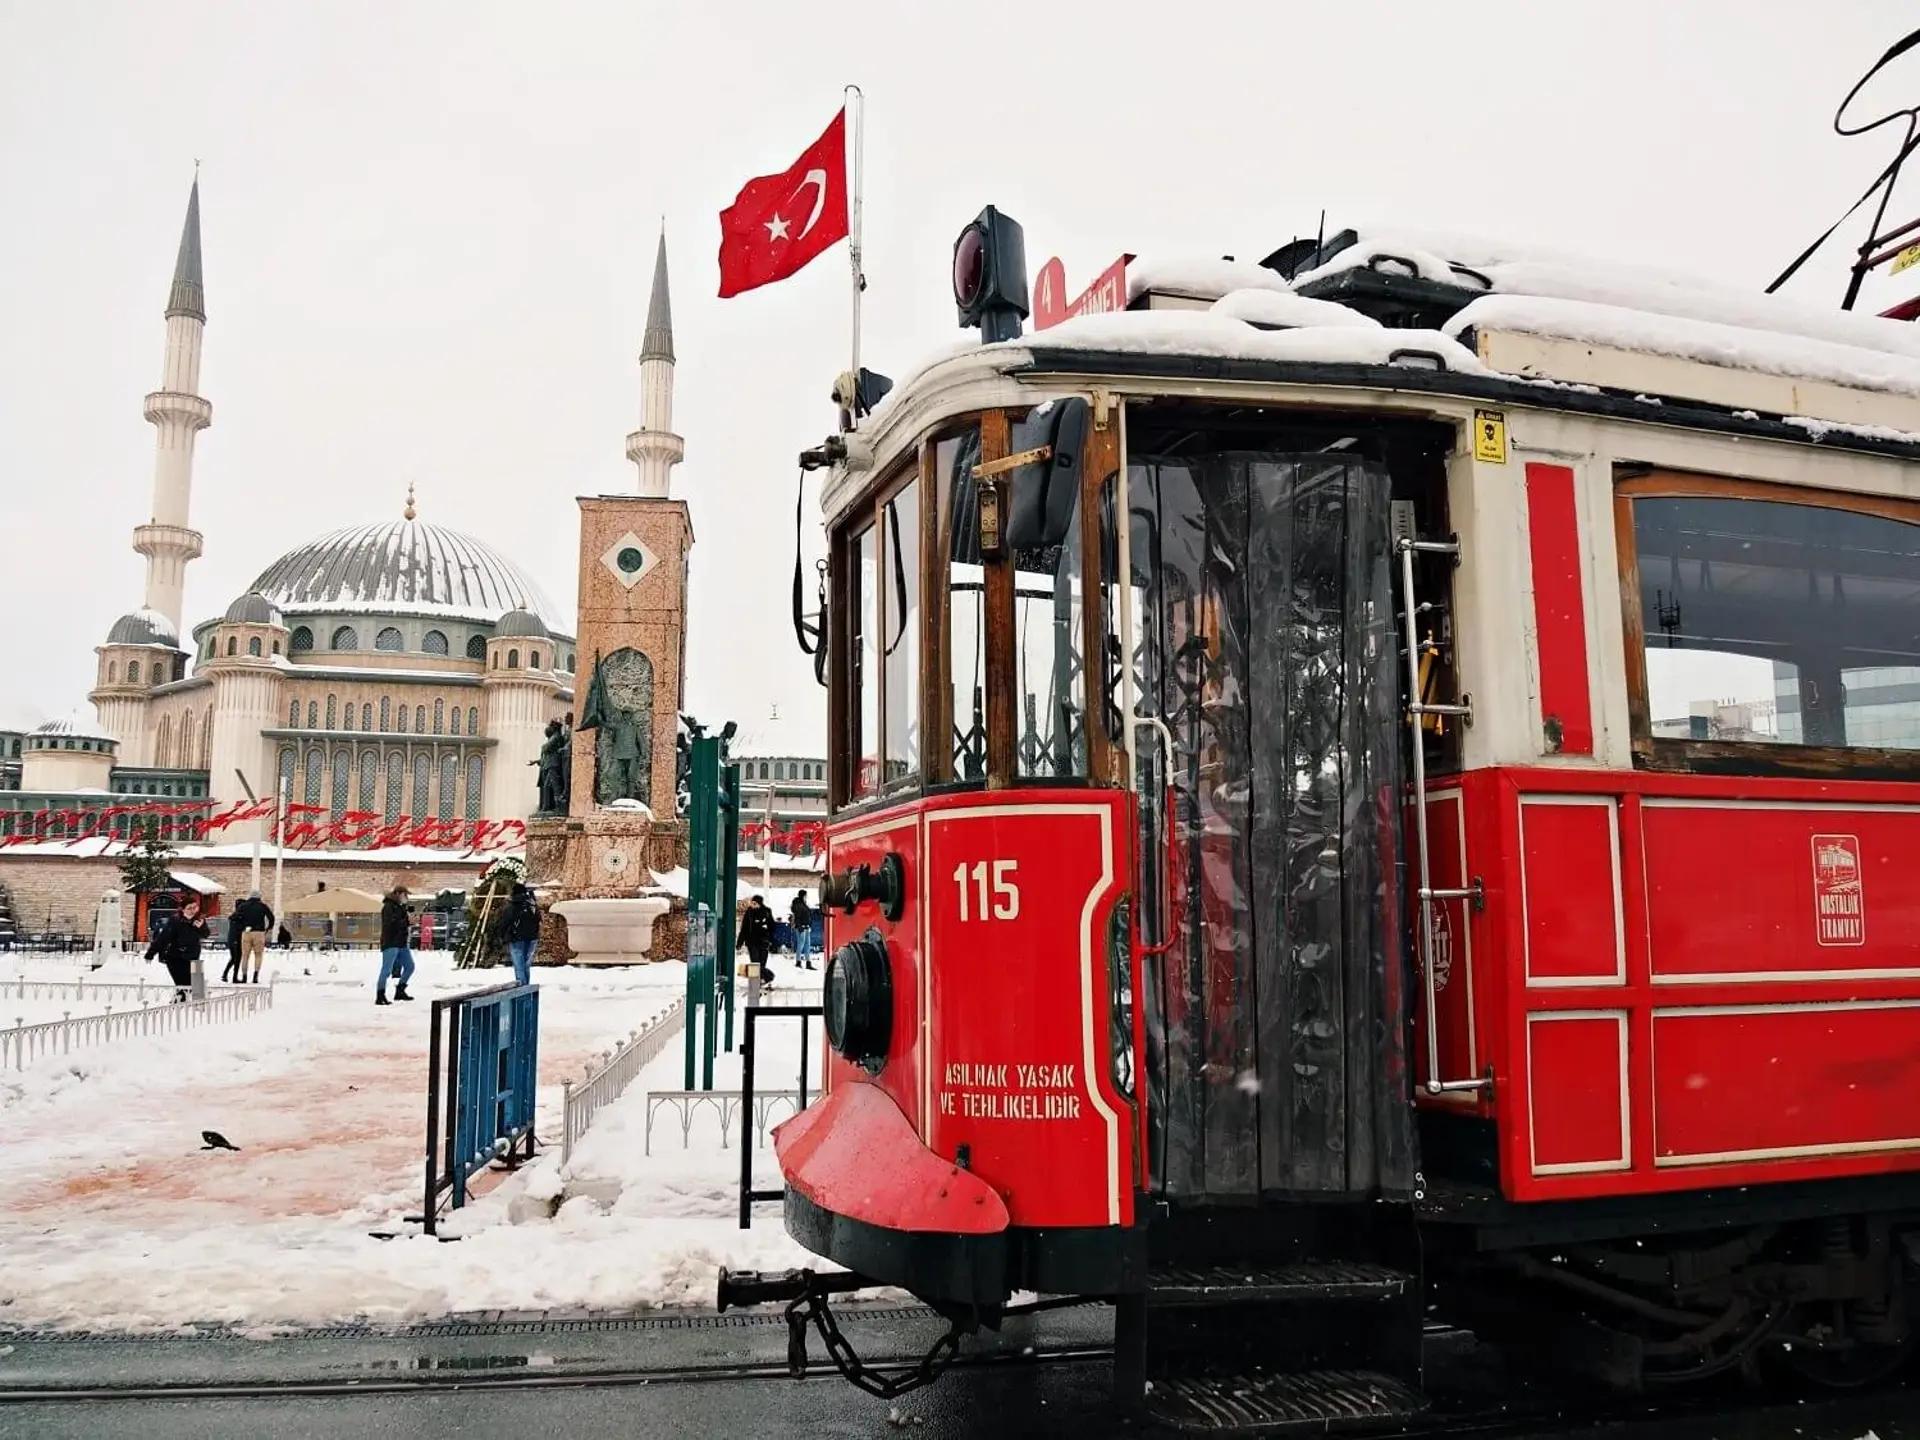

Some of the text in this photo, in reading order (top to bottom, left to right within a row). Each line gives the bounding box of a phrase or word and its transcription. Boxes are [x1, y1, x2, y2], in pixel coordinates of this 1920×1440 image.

[953, 860, 1019, 922] 115
[1820, 918, 1861, 939] TRAMVAY
[945, 1063, 1075, 1089] ASILMAK YASAK
[940, 1091, 1081, 1119] VE TEHLİKELİDİR
